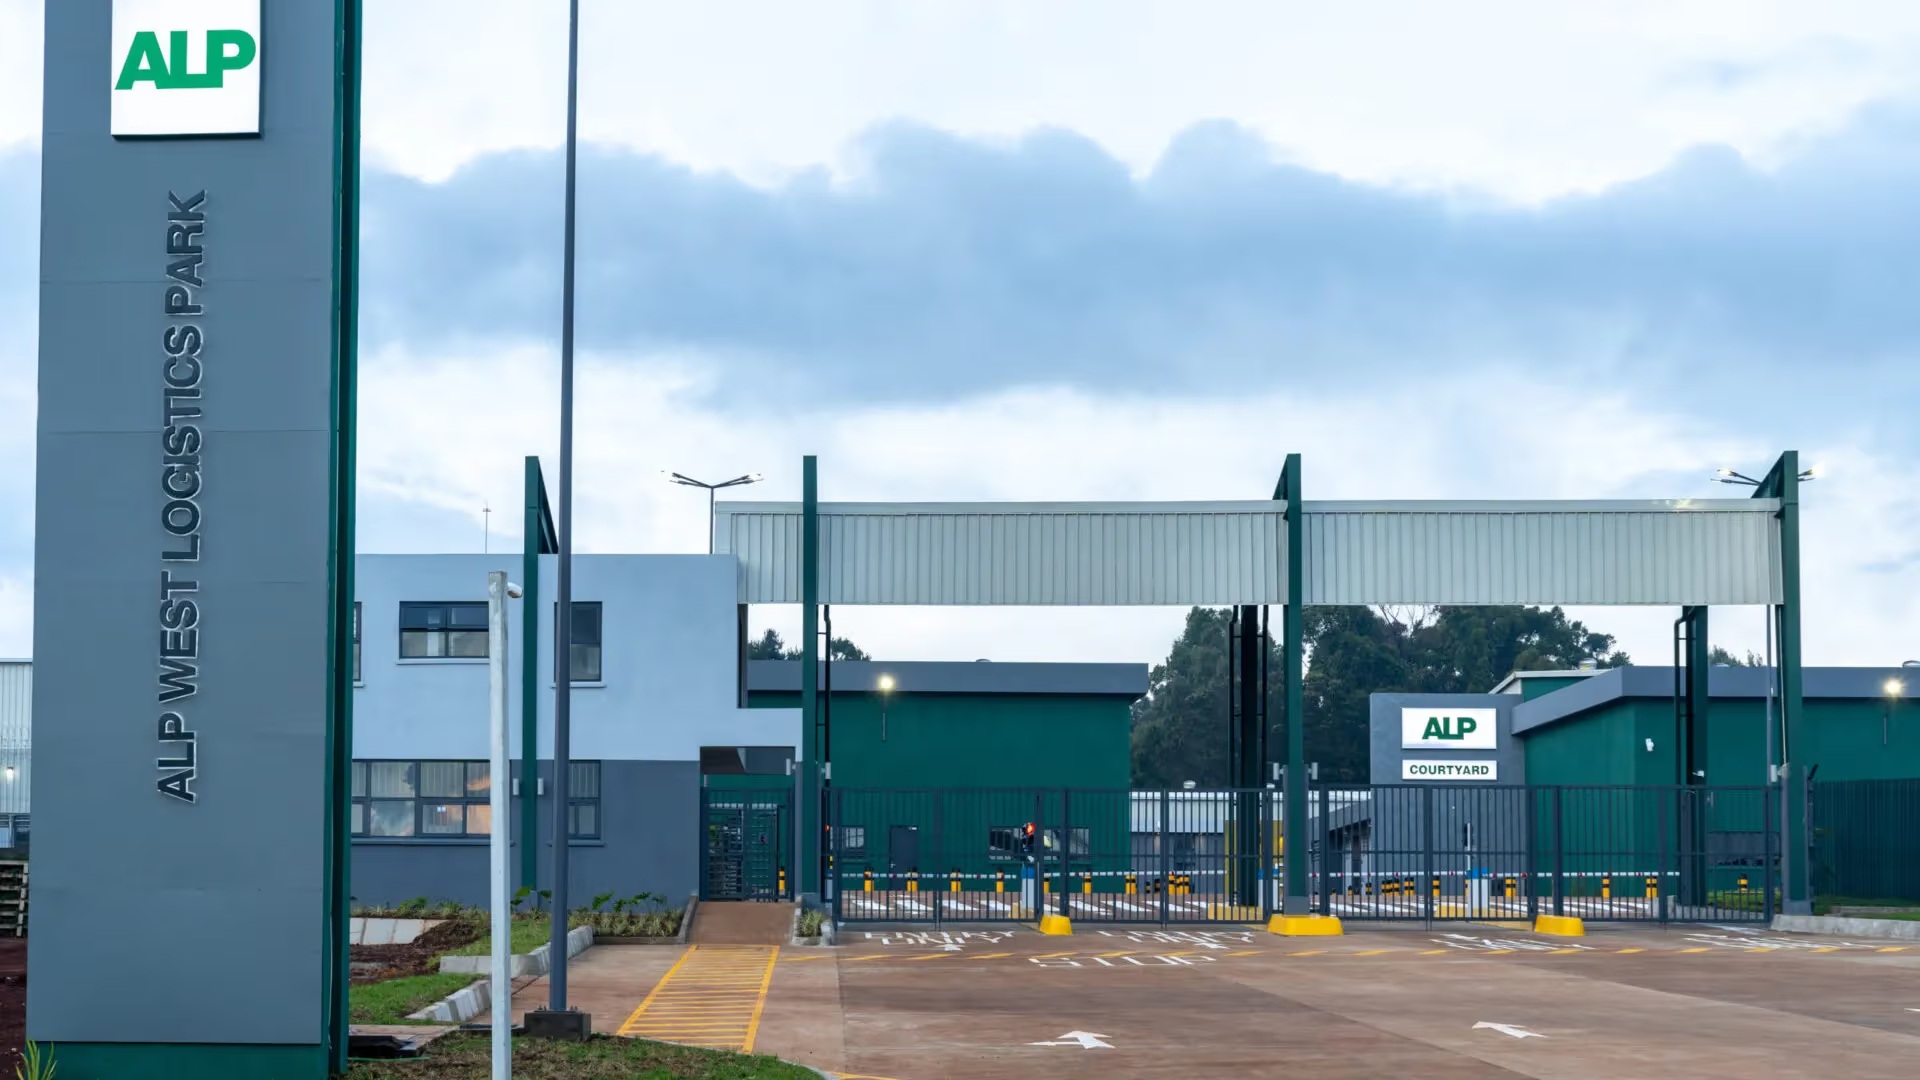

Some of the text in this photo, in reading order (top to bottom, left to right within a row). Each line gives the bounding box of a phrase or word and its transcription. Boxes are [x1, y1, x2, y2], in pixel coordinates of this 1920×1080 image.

[115, 29, 256, 90] ALP
[157, 189, 207, 803] ALP WEST LOGISTICS PARK
[1422, 716, 1477, 740] ALP
[1409, 765, 1489, 775] COURTYARD
[1028, 955, 1216, 967] STOP
